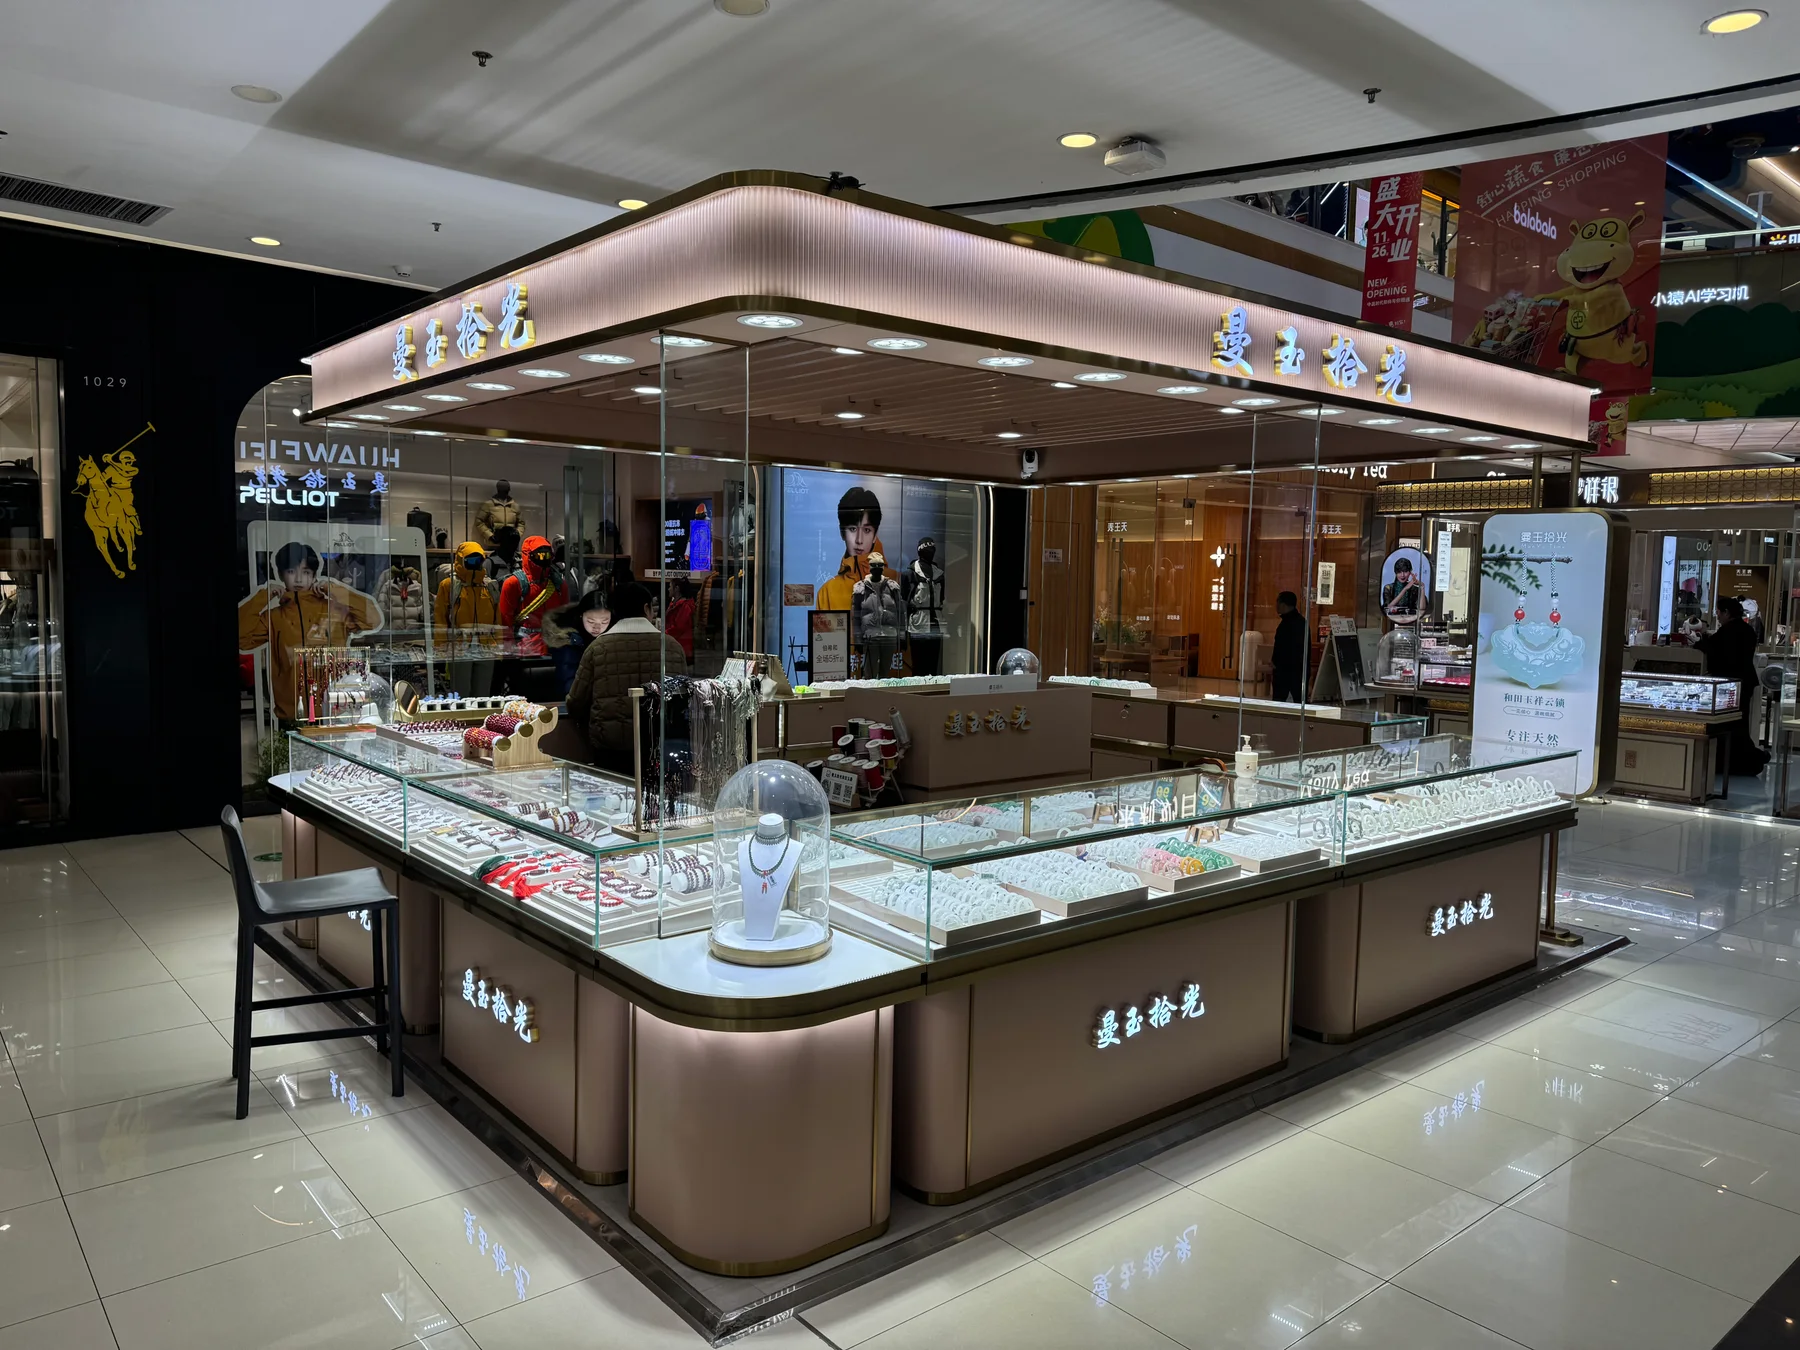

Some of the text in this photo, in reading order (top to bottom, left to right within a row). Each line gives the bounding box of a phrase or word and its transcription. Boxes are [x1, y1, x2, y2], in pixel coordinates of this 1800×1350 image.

[1557, 151, 1628, 192] SHOPPING
[1513, 202, 1557, 240] balabala
[1366, 285, 1408, 299] OPENING
[1367, 277, 1389, 288] NEW
[1650, 285, 1750, 307] 小猿AI学习机
[393, 283, 536, 381] 曼玉拾光
[1212, 306, 1412, 404] 曼玉拾光
[83, 376, 127, 388] 1029
[239, 485, 340, 507] PELLIOT
[944, 704, 1032, 737] 曼玉拾光
[1505, 729, 1559, 748] 专注天然
[1429, 892, 1495, 937] 曼玉拾光
[462, 967, 536, 1043] 曼玉拾光
[1095, 982, 1206, 1049] 曼玉拾光
